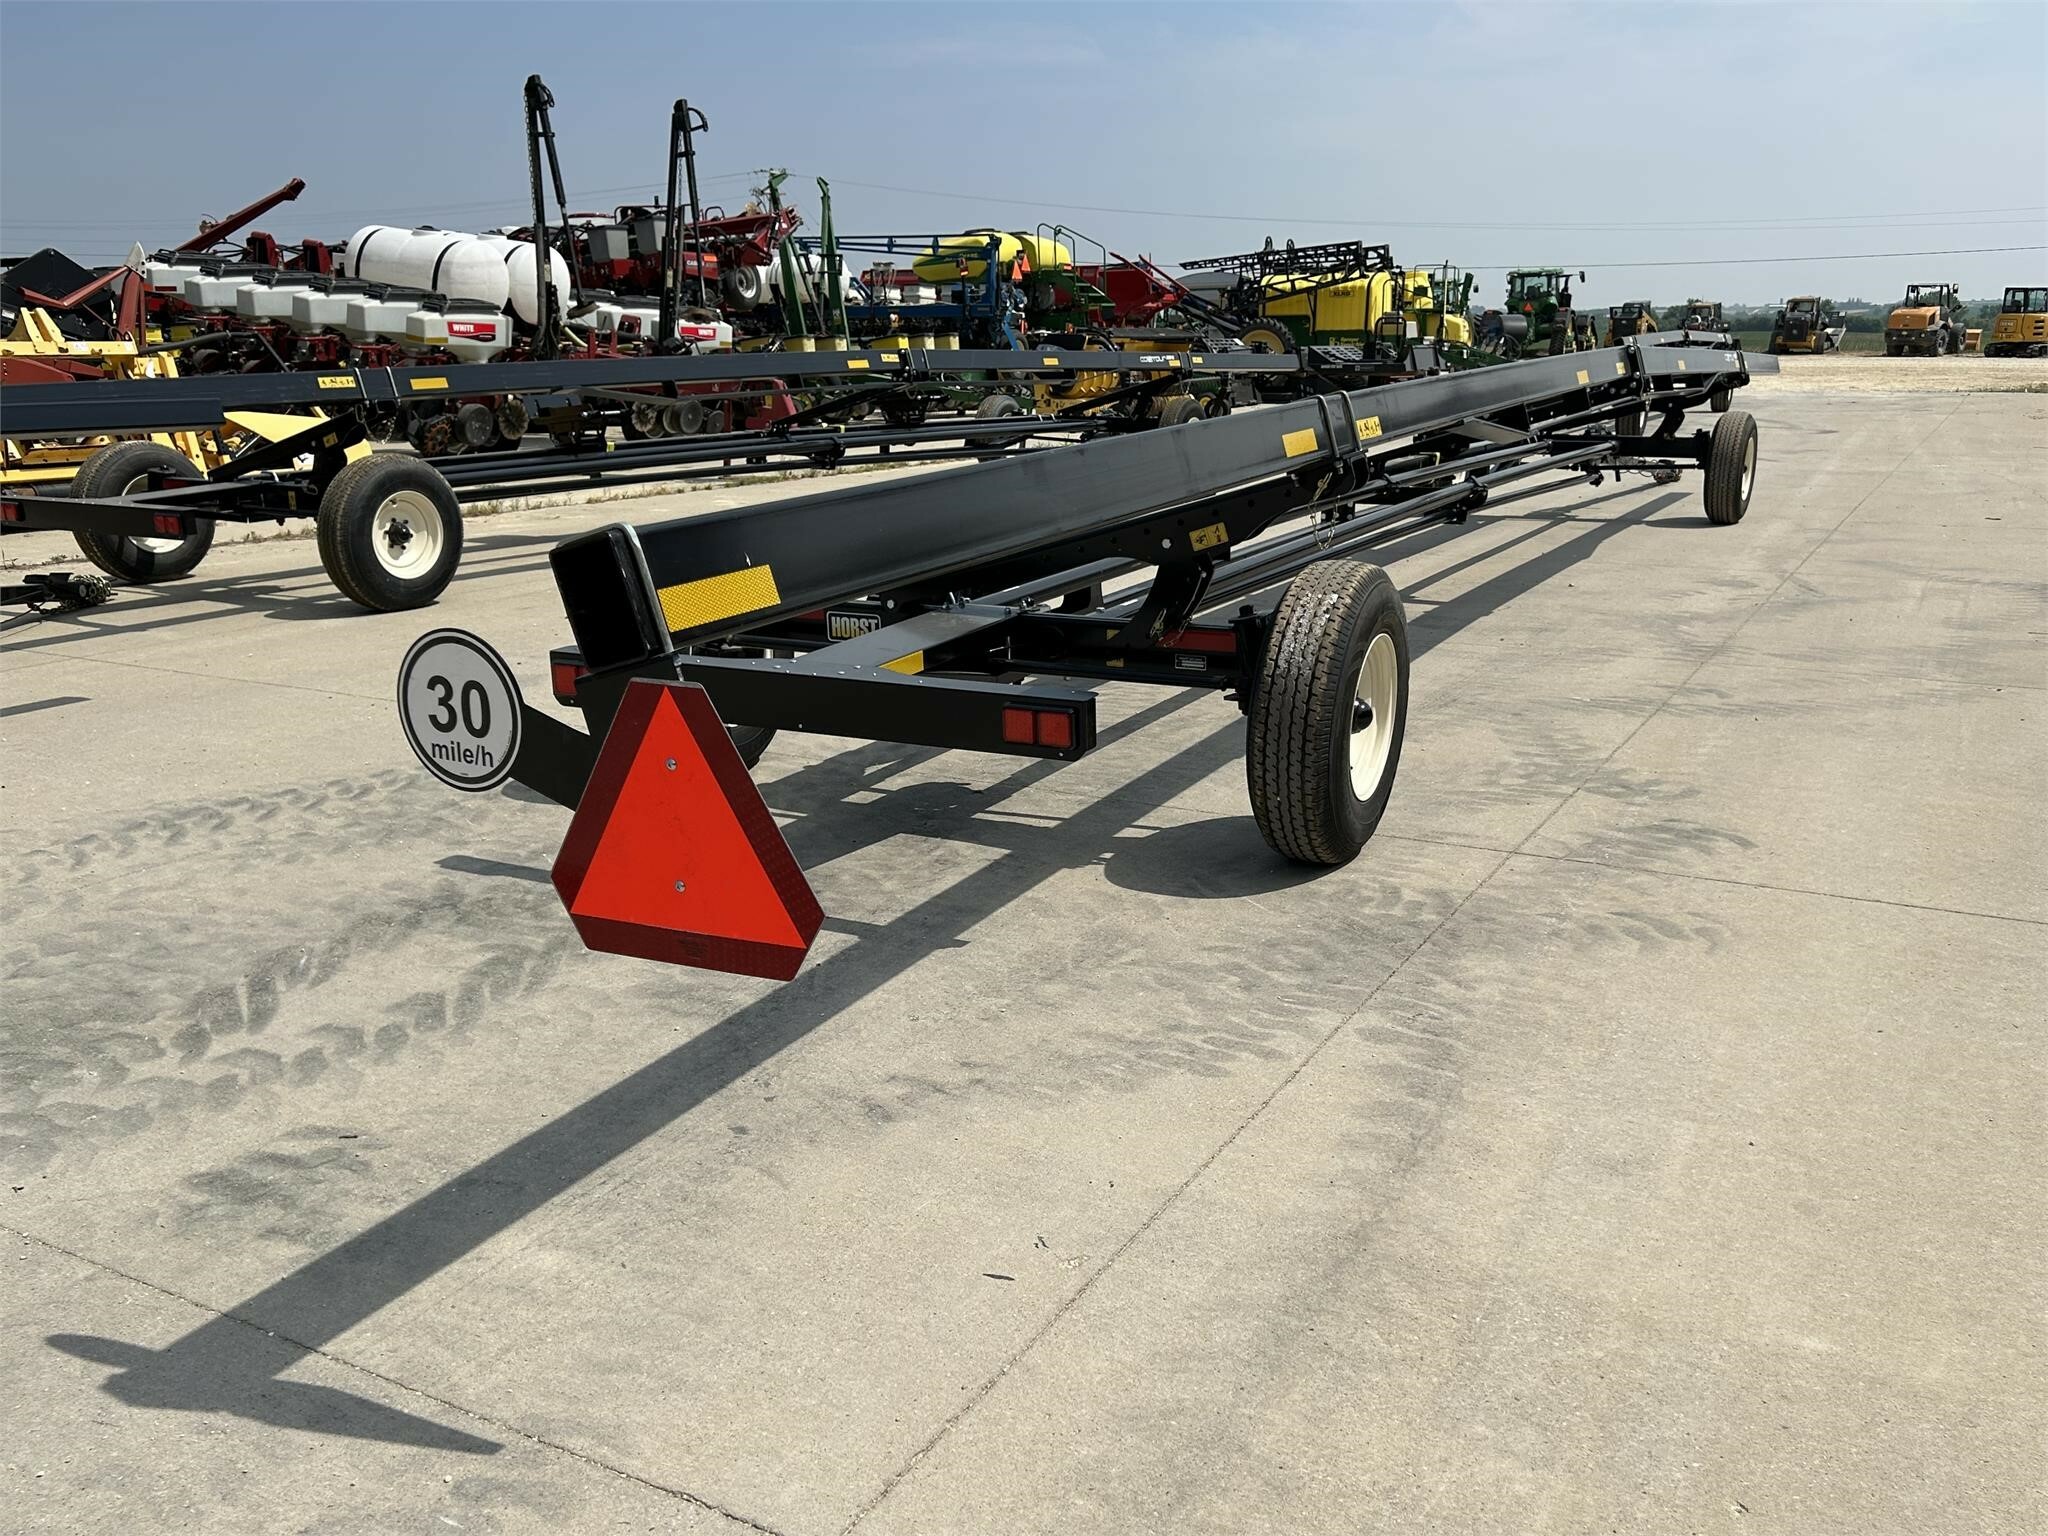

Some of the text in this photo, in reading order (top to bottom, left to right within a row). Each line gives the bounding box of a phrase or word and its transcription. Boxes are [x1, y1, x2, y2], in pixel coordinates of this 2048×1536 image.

[452, 323, 475, 332] WHITE
[831, 616, 878, 638] HORST
[427, 675, 491, 738] 30
[432, 740, 494, 768] mile/h
